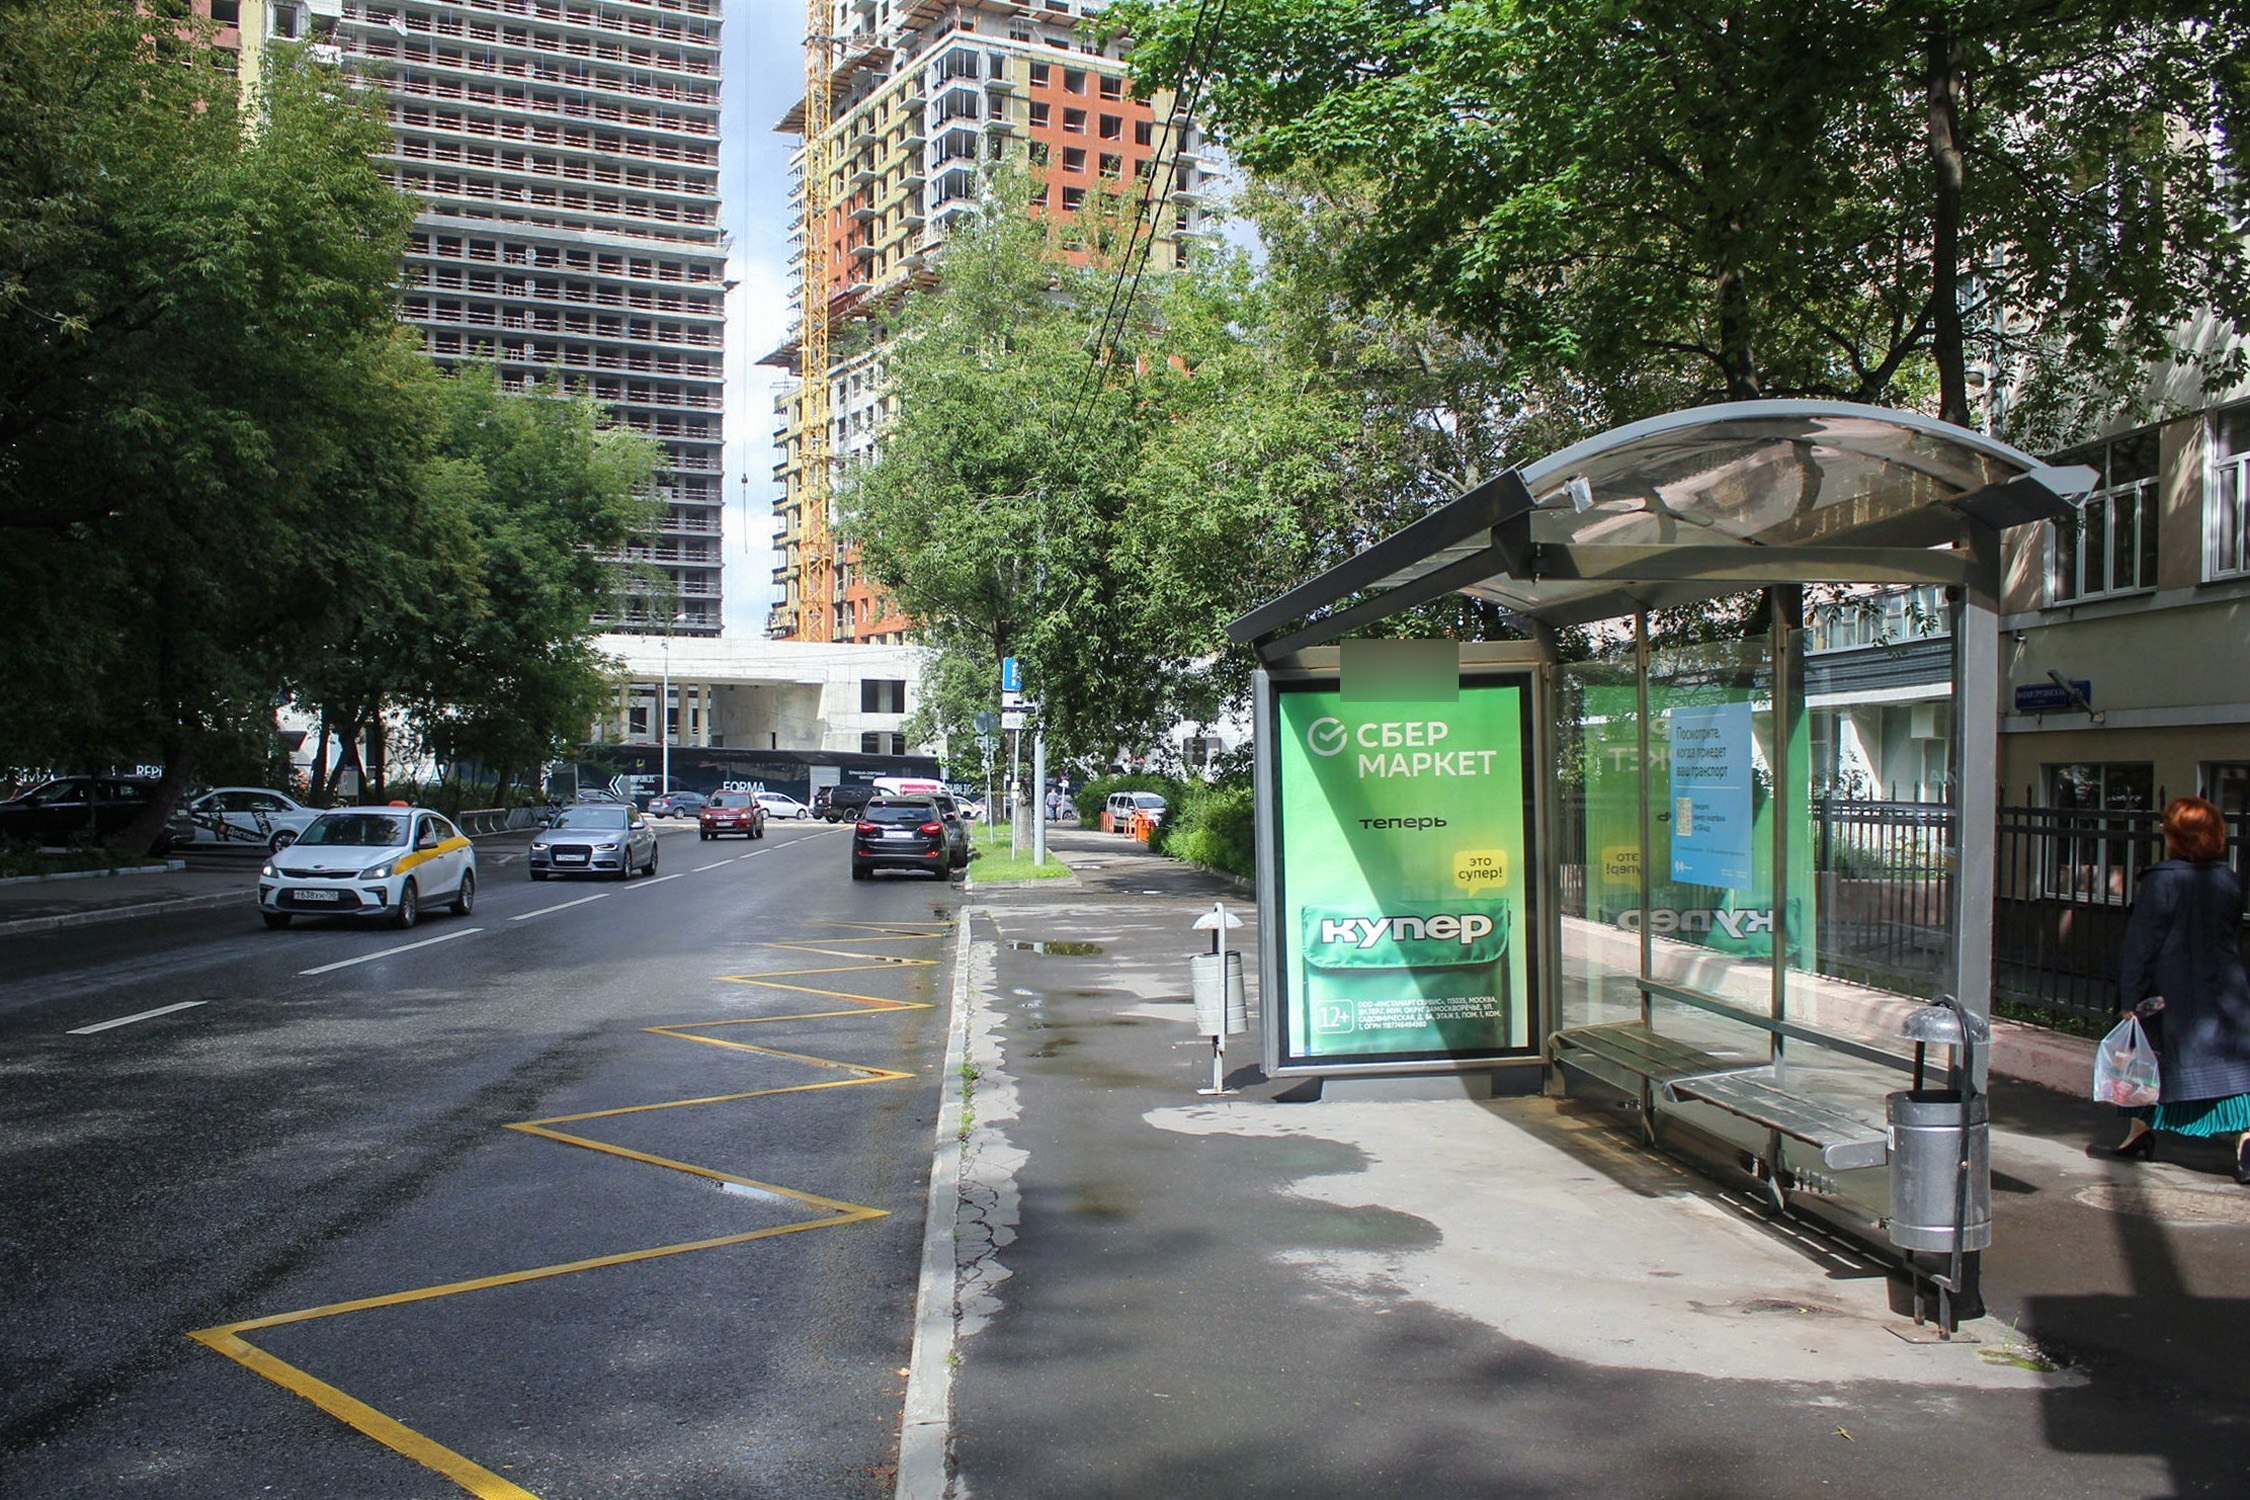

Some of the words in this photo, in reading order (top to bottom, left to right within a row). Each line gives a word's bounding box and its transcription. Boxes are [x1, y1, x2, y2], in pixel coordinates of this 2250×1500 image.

[1356, 721, 1449, 748] СБЕР
[1358, 750, 1497, 778] МАРКЕТ
[723, 780, 766, 793] FORMA
[1359, 816, 1448, 831] теперь
[1469, 857, 1492, 867] это
[1458, 866, 1503, 881] супер!
[1320, 913, 1494, 950] купер
[1357, 1000, 1374, 1009] ООО
[1468, 995, 1498, 1005] МОСКВА,
[1319, 1004, 1350, 1029] 12+
[1436, 1012, 1454, 1020] ЭТАЖ
